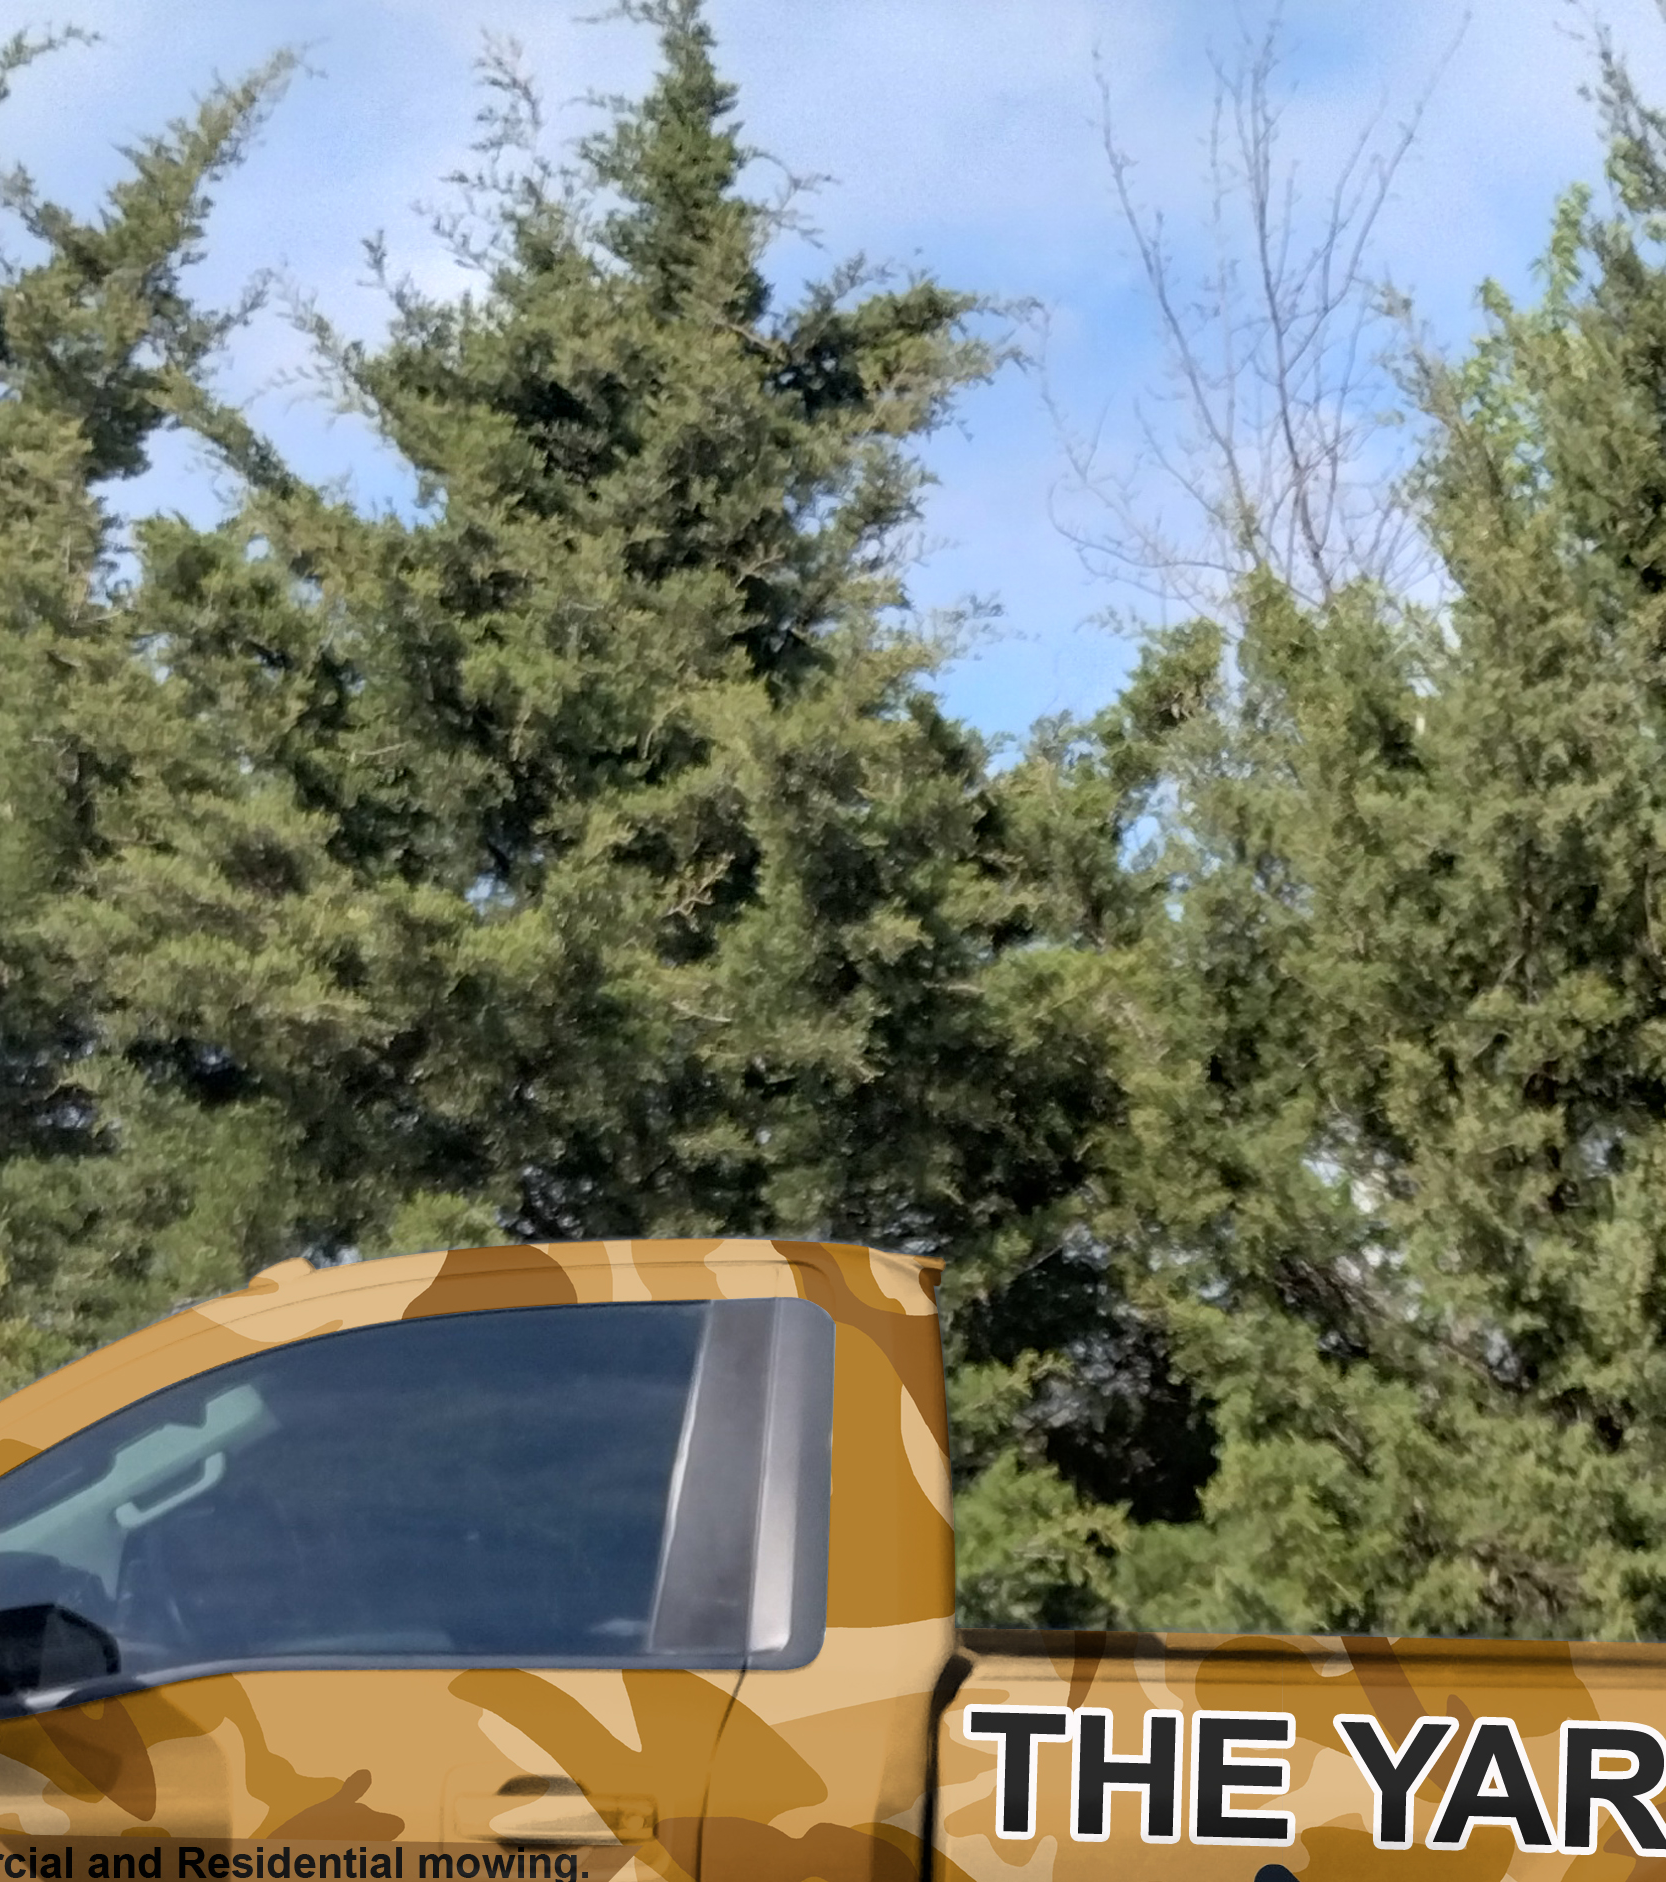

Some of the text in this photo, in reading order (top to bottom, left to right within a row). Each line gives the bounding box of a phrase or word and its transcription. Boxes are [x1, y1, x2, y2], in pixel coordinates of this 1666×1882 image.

[963, 1703, 1296, 1847] THE
[87, 1846, 162, 1879] and
[179, 1846, 403, 1879] Residential
